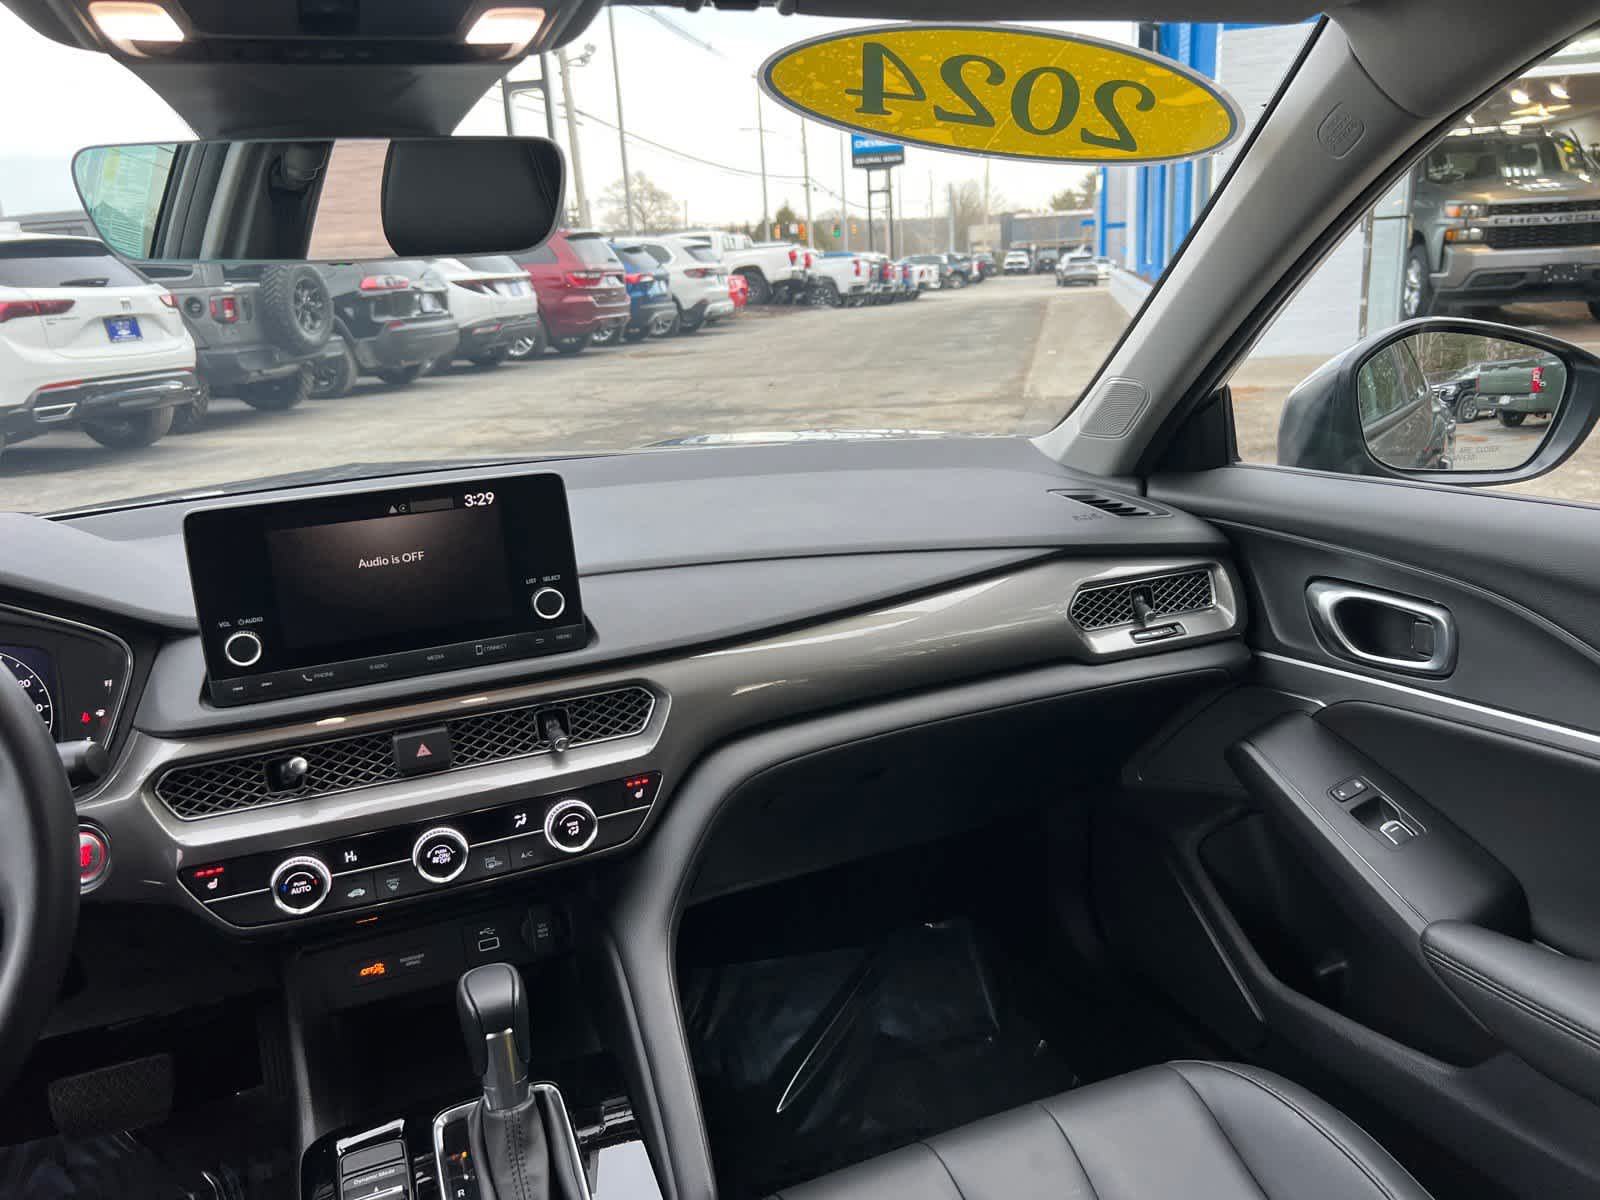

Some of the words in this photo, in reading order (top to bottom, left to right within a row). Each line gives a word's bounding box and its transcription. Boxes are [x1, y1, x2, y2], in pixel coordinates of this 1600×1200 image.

[464, 491, 495, 508] 3:29
[358, 556, 389, 568] Audio
[391, 554, 401, 564] is
[401, 551, 425, 563] OFF
[244, 616, 263, 624] AUDIO
[290, 884, 312, 896] AUTO
